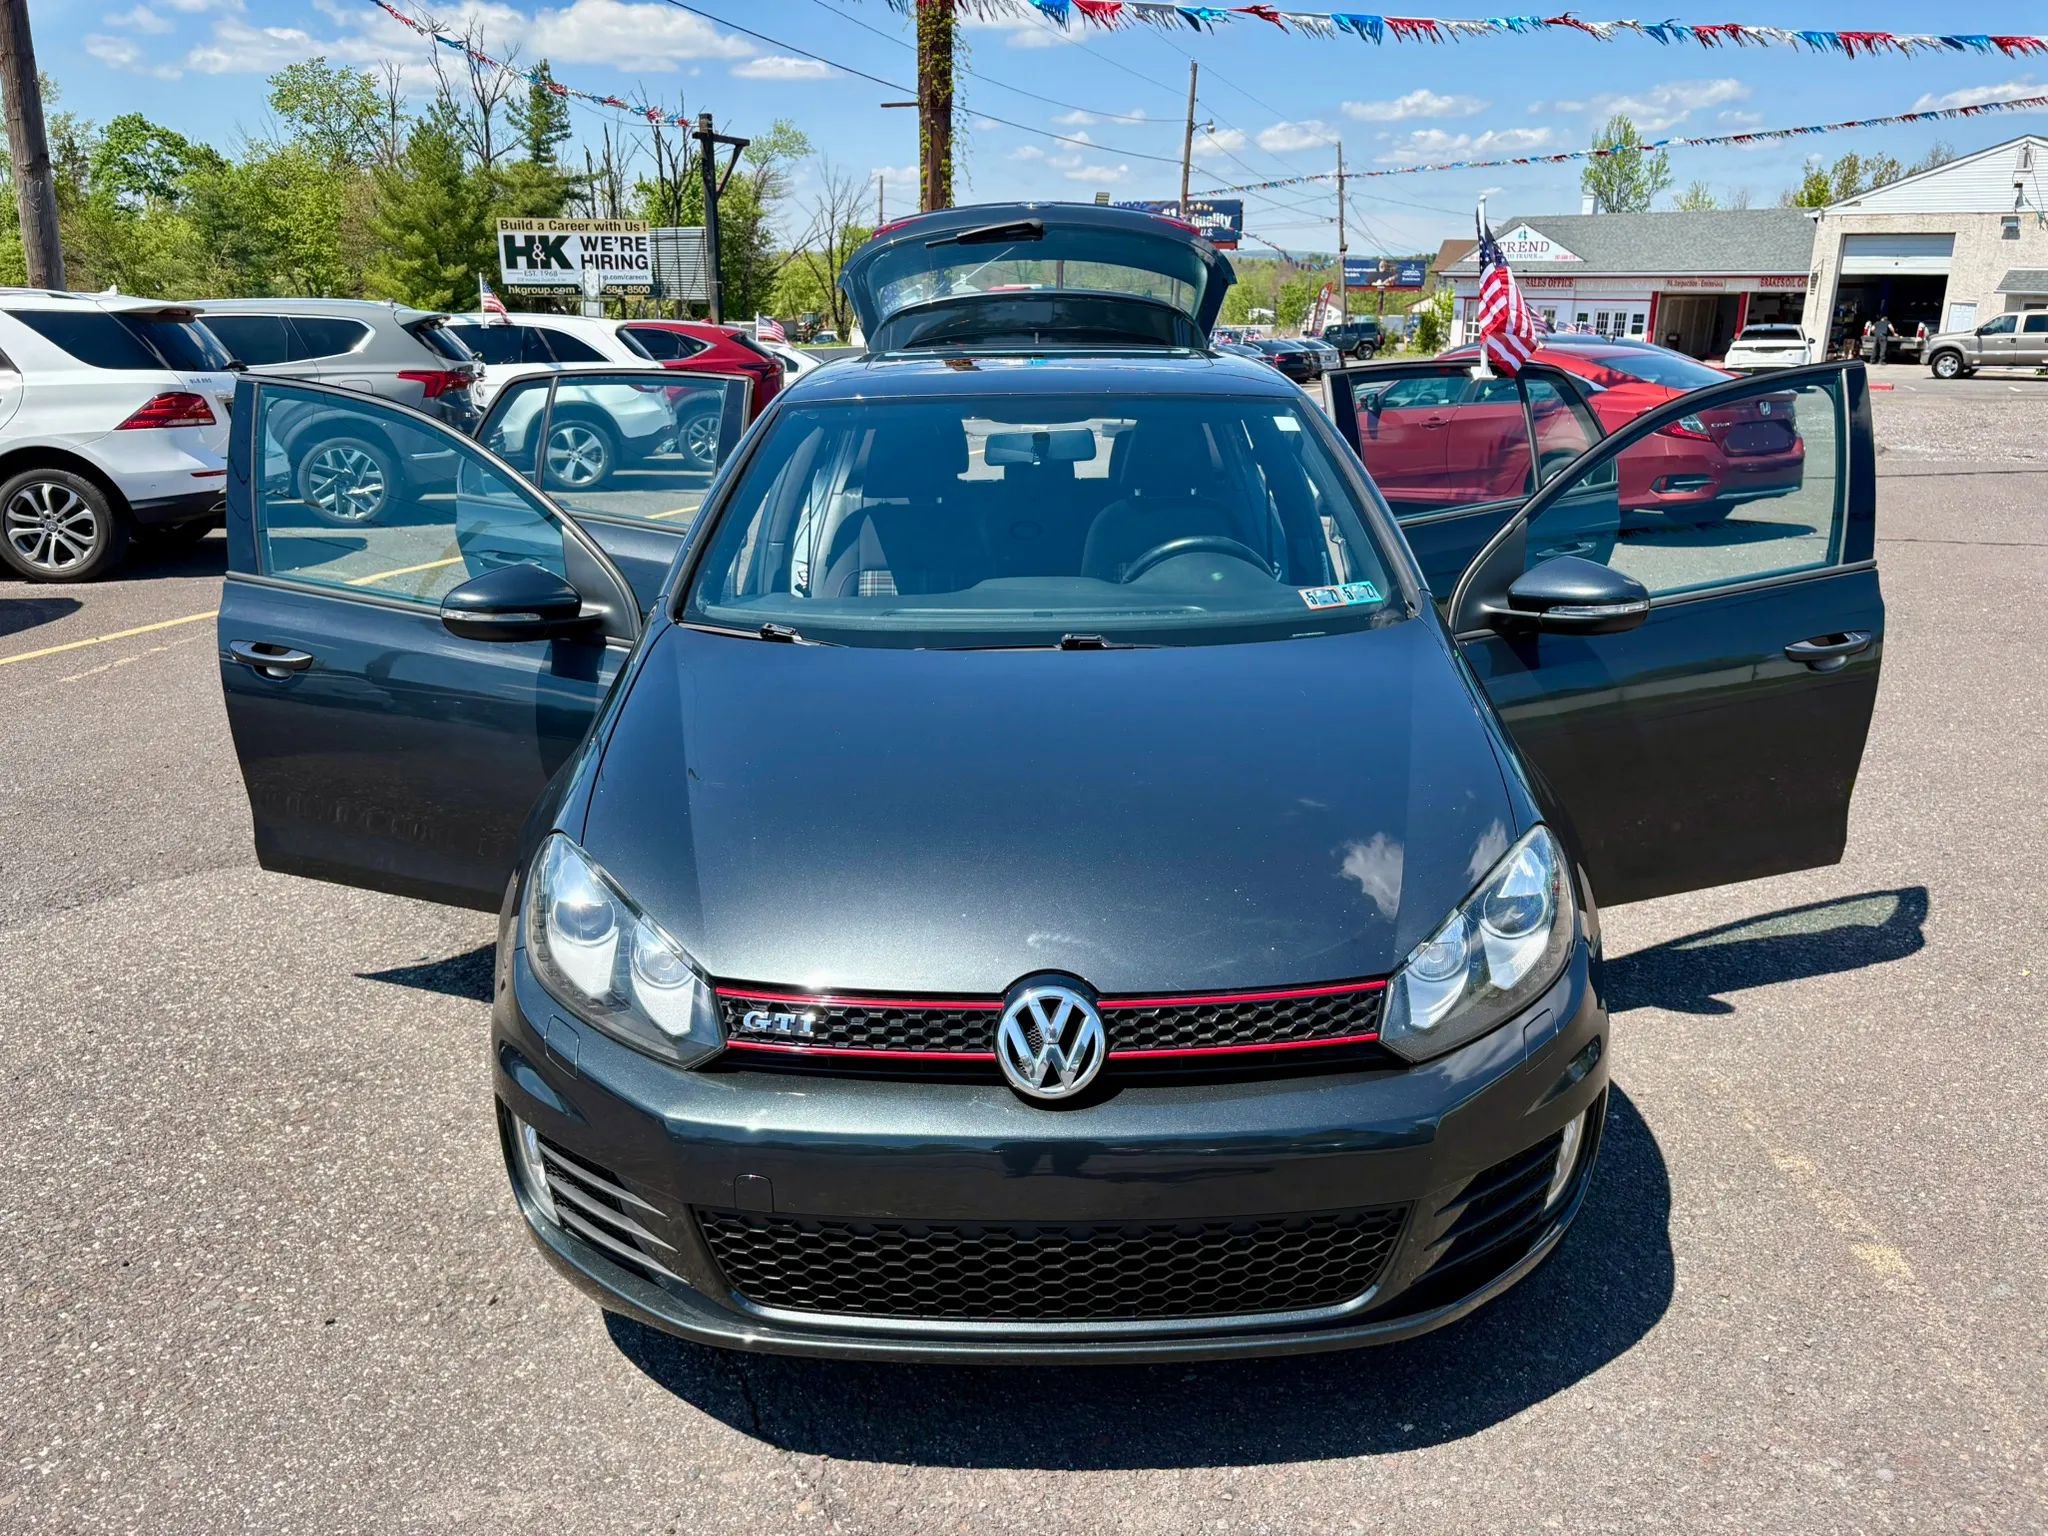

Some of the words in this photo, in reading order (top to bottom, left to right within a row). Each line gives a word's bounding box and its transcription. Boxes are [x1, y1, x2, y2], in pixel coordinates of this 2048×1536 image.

[500, 219, 533, 231] Build
[537, 222, 545, 231] a
[548, 220, 590, 232] Career
[593, 221, 621, 232] with
[503, 234, 575, 270] H&K
[579, 235, 648, 252] WE'RE
[1499, 241, 1550, 253] TREND
[581, 253, 649, 270] HIRING
[508, 285, 575, 296] hkgroup.com
[1525, 278, 1546, 288] SALES
[1548, 278, 1573, 288] OFFICE
[1305, 591, 1318, 605] 5
[1342, 586, 1354, 601] 5
[743, 1010, 816, 1035] GTI
